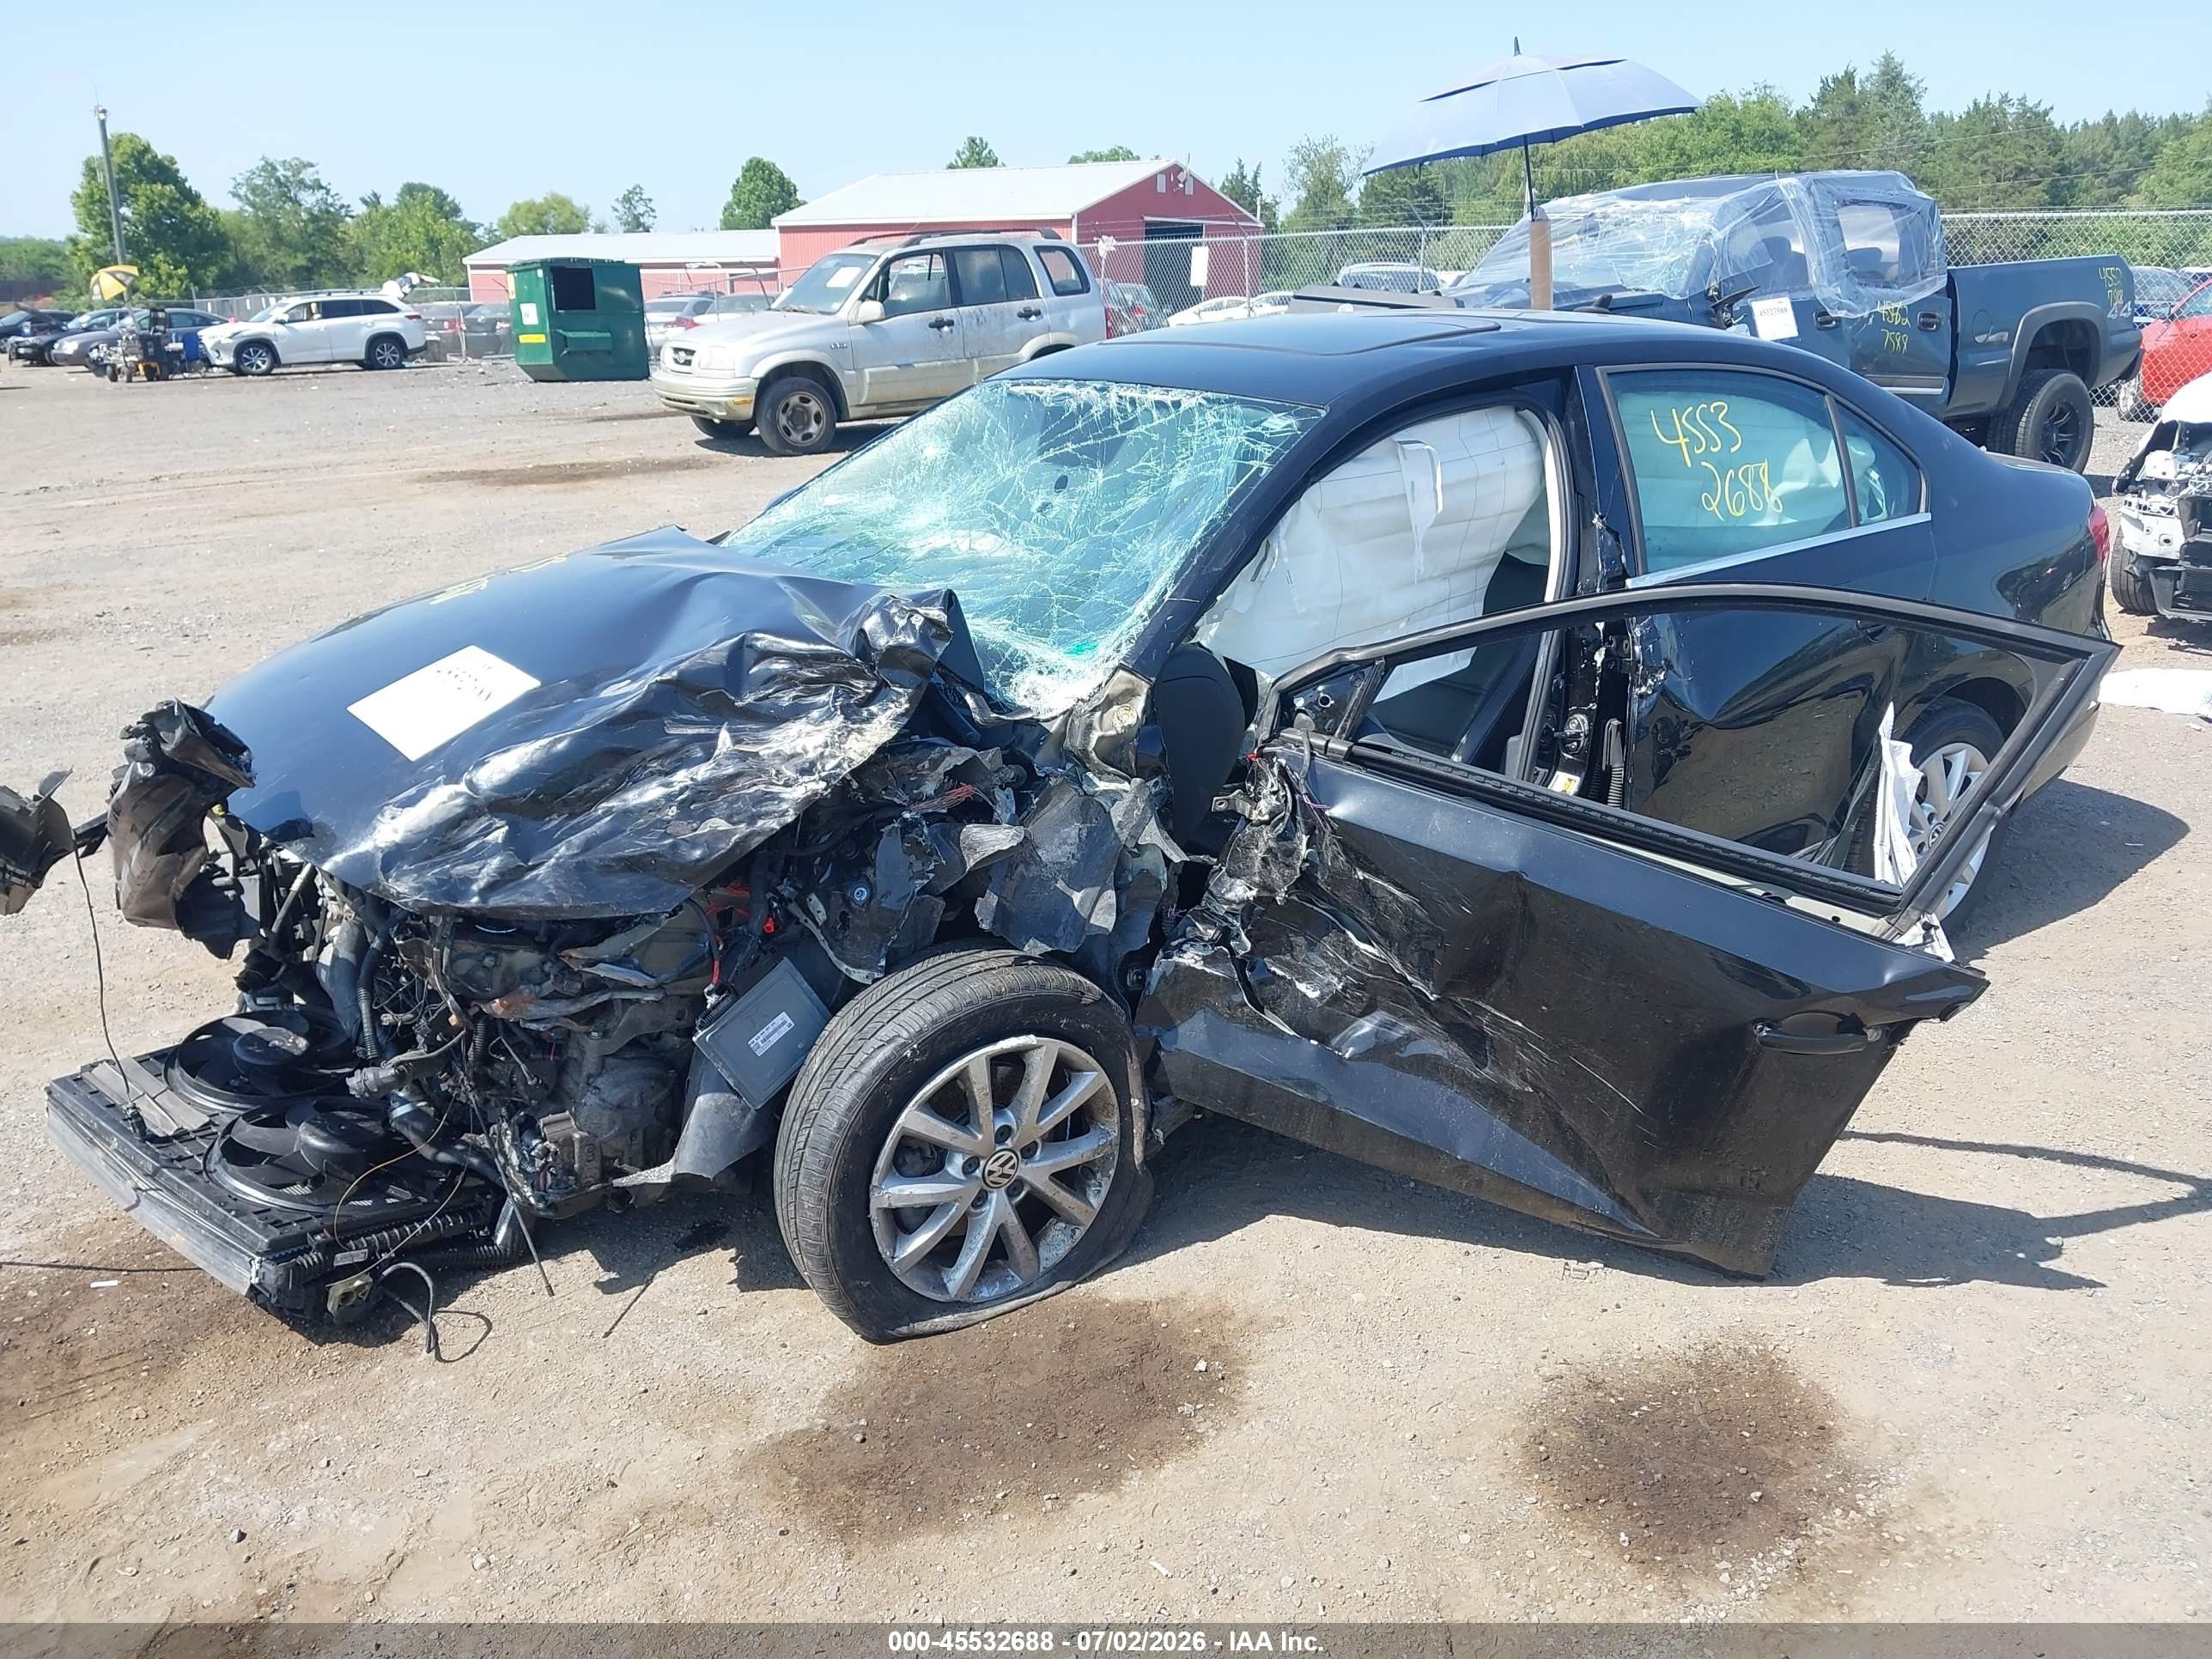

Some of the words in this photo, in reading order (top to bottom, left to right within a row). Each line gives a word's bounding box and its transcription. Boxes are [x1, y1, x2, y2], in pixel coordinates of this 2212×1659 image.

[2107, 300, 2133, 319] 44
[1881, 328, 1909, 356] 7588
[1650, 401, 1742, 467] 4553
[1699, 459, 1784, 521] 2688
